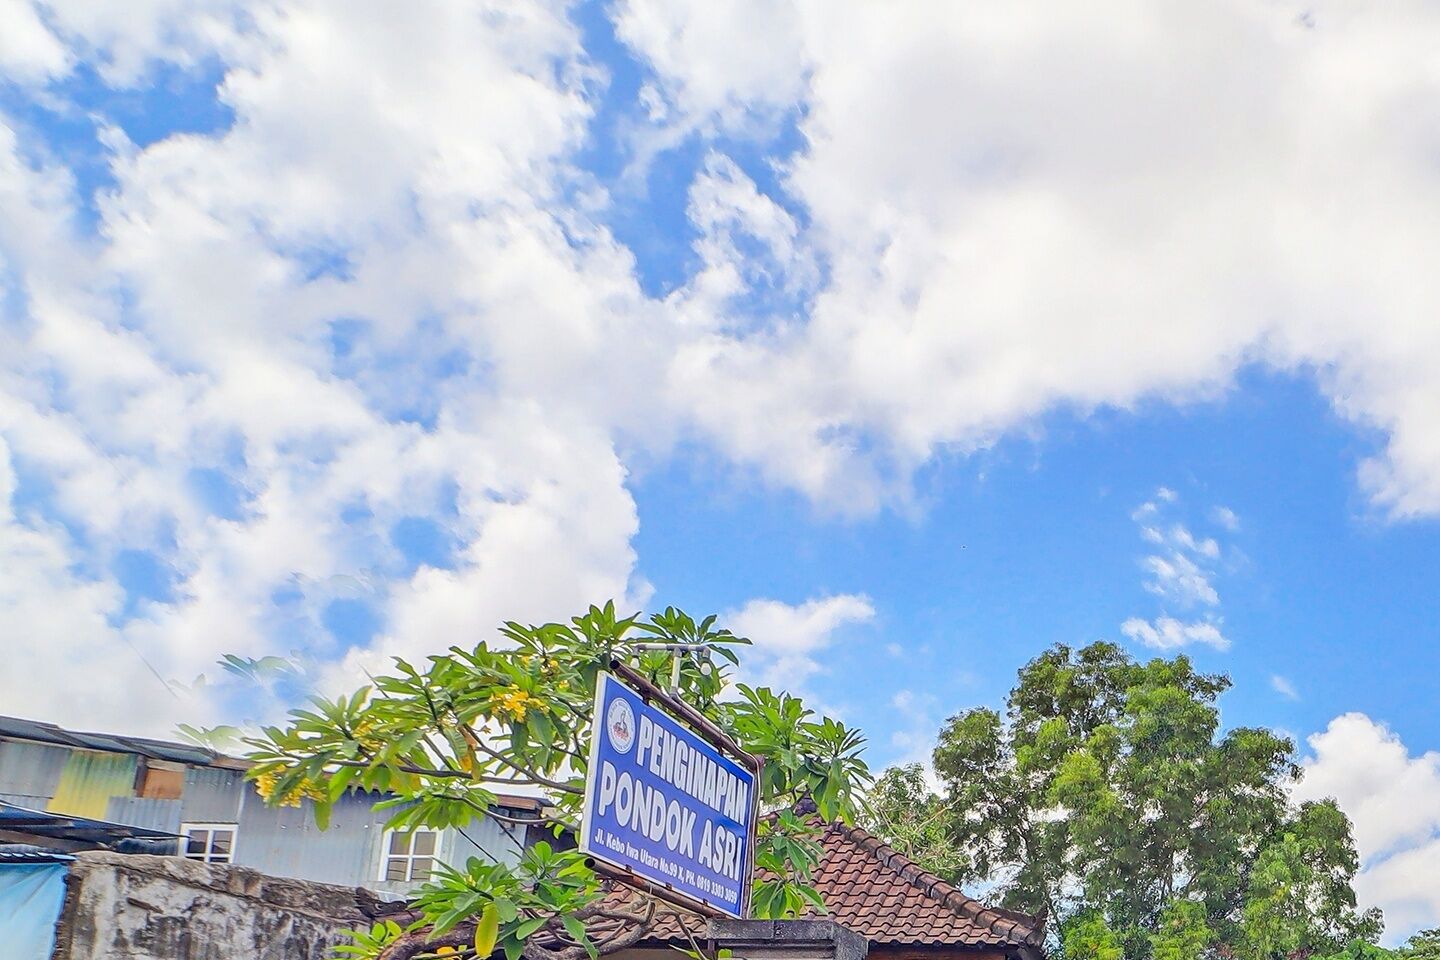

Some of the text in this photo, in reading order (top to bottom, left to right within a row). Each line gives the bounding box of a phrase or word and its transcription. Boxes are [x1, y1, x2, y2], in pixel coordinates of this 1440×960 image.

[599, 763, 743, 882] PONDOK ASRI
[636, 714, 748, 826] PENGINAPAN
[606, 832, 625, 854] Kebo
[626, 841, 639, 860] Iwa
[640, 849, 659, 870] Utara
